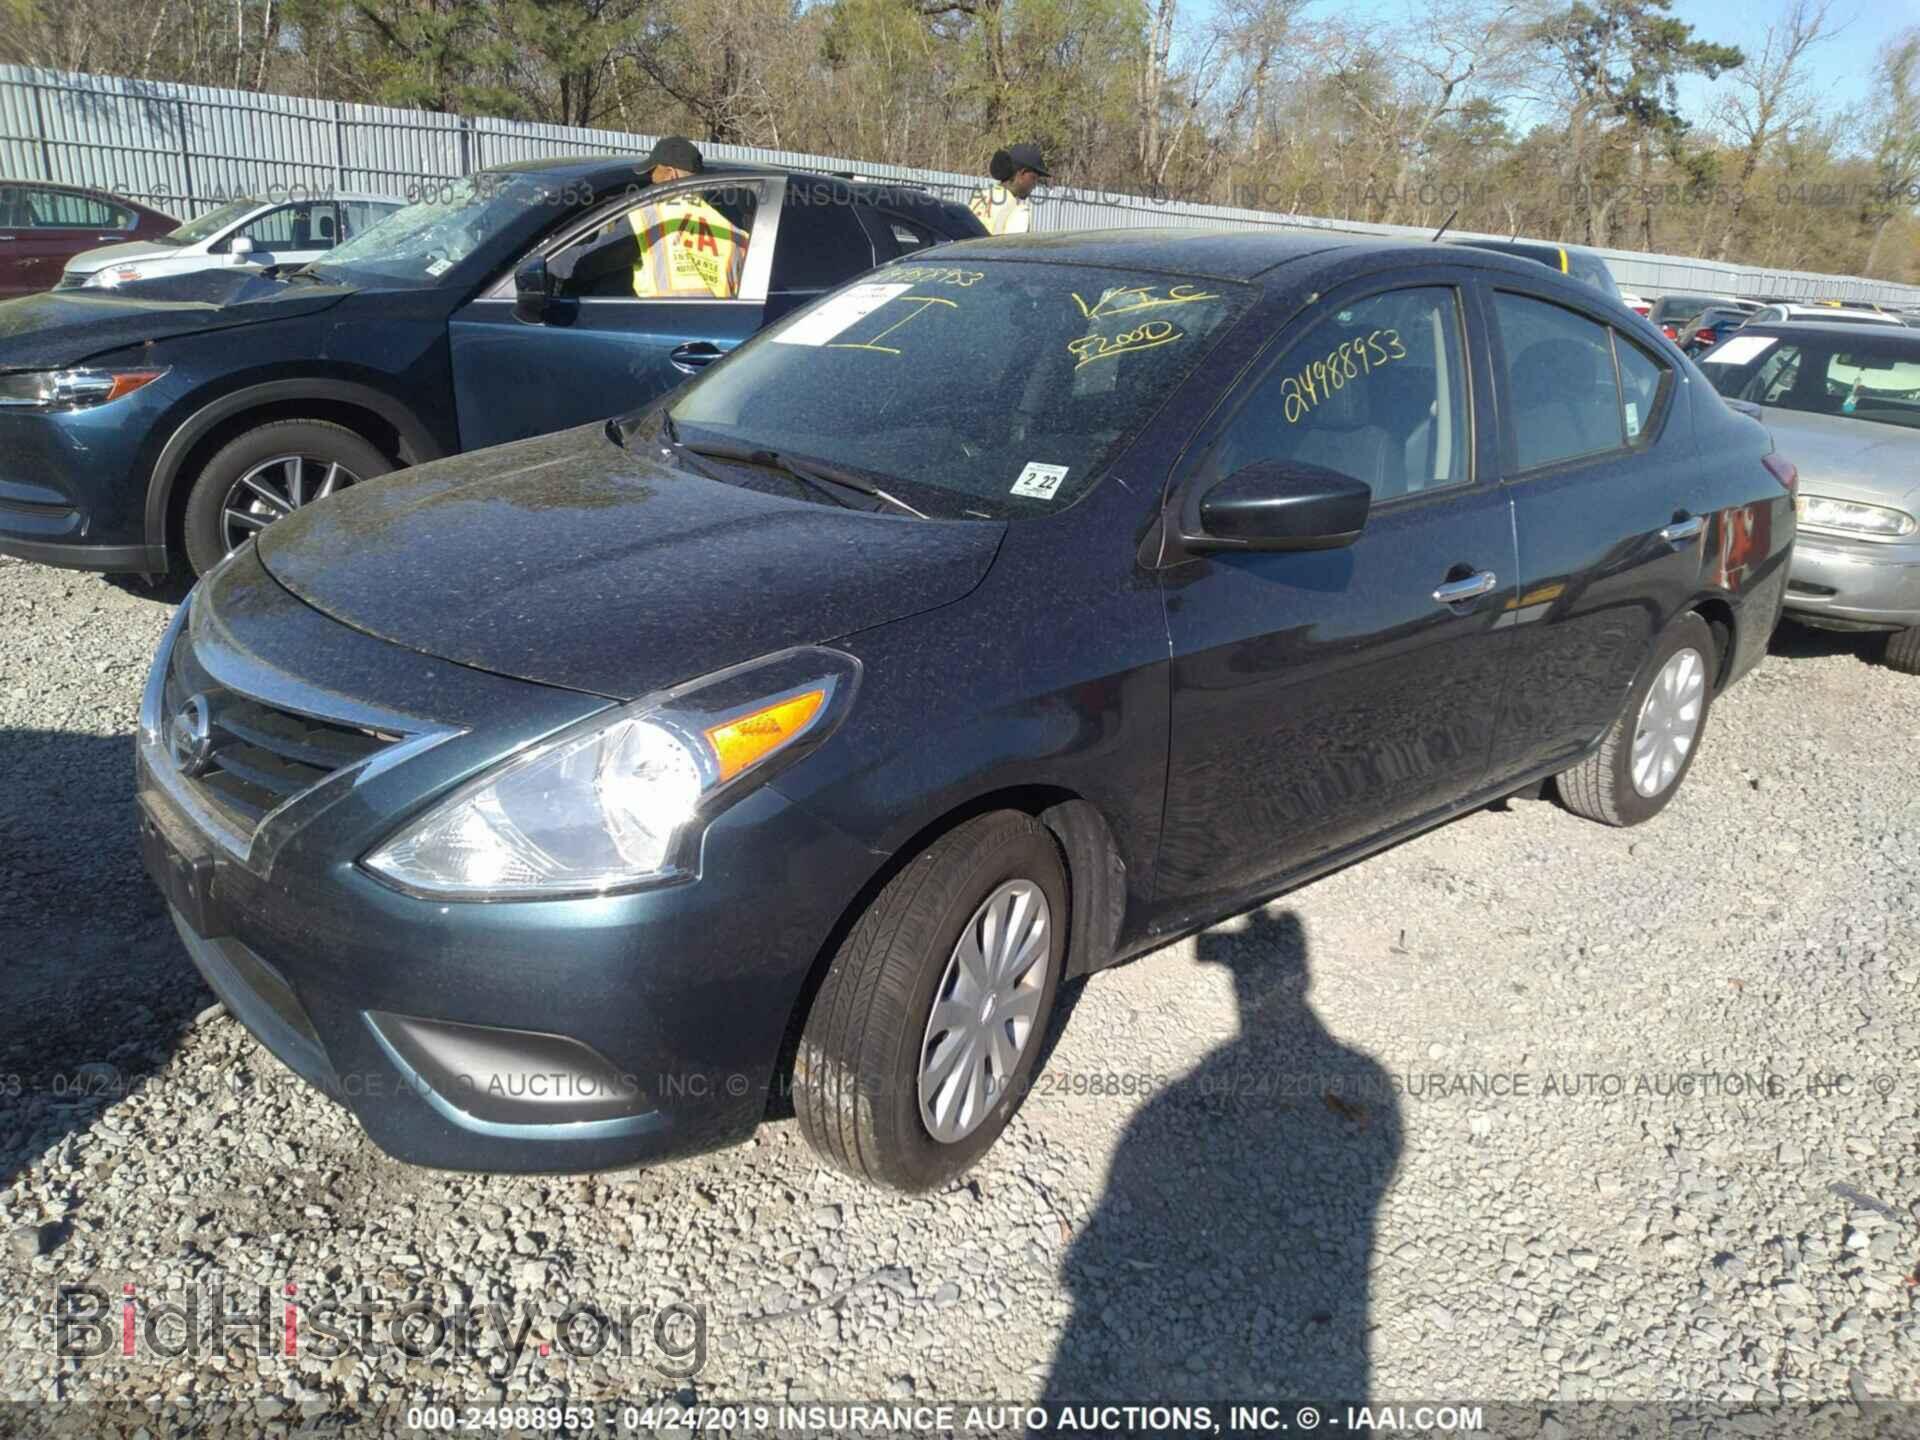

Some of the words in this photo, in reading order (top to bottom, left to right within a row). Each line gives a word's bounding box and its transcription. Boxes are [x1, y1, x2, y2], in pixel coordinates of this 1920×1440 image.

[1280, 329, 1407, 423] 24988953
[1024, 472, 1037, 486] 2
[1038, 475, 1058, 490] 22
